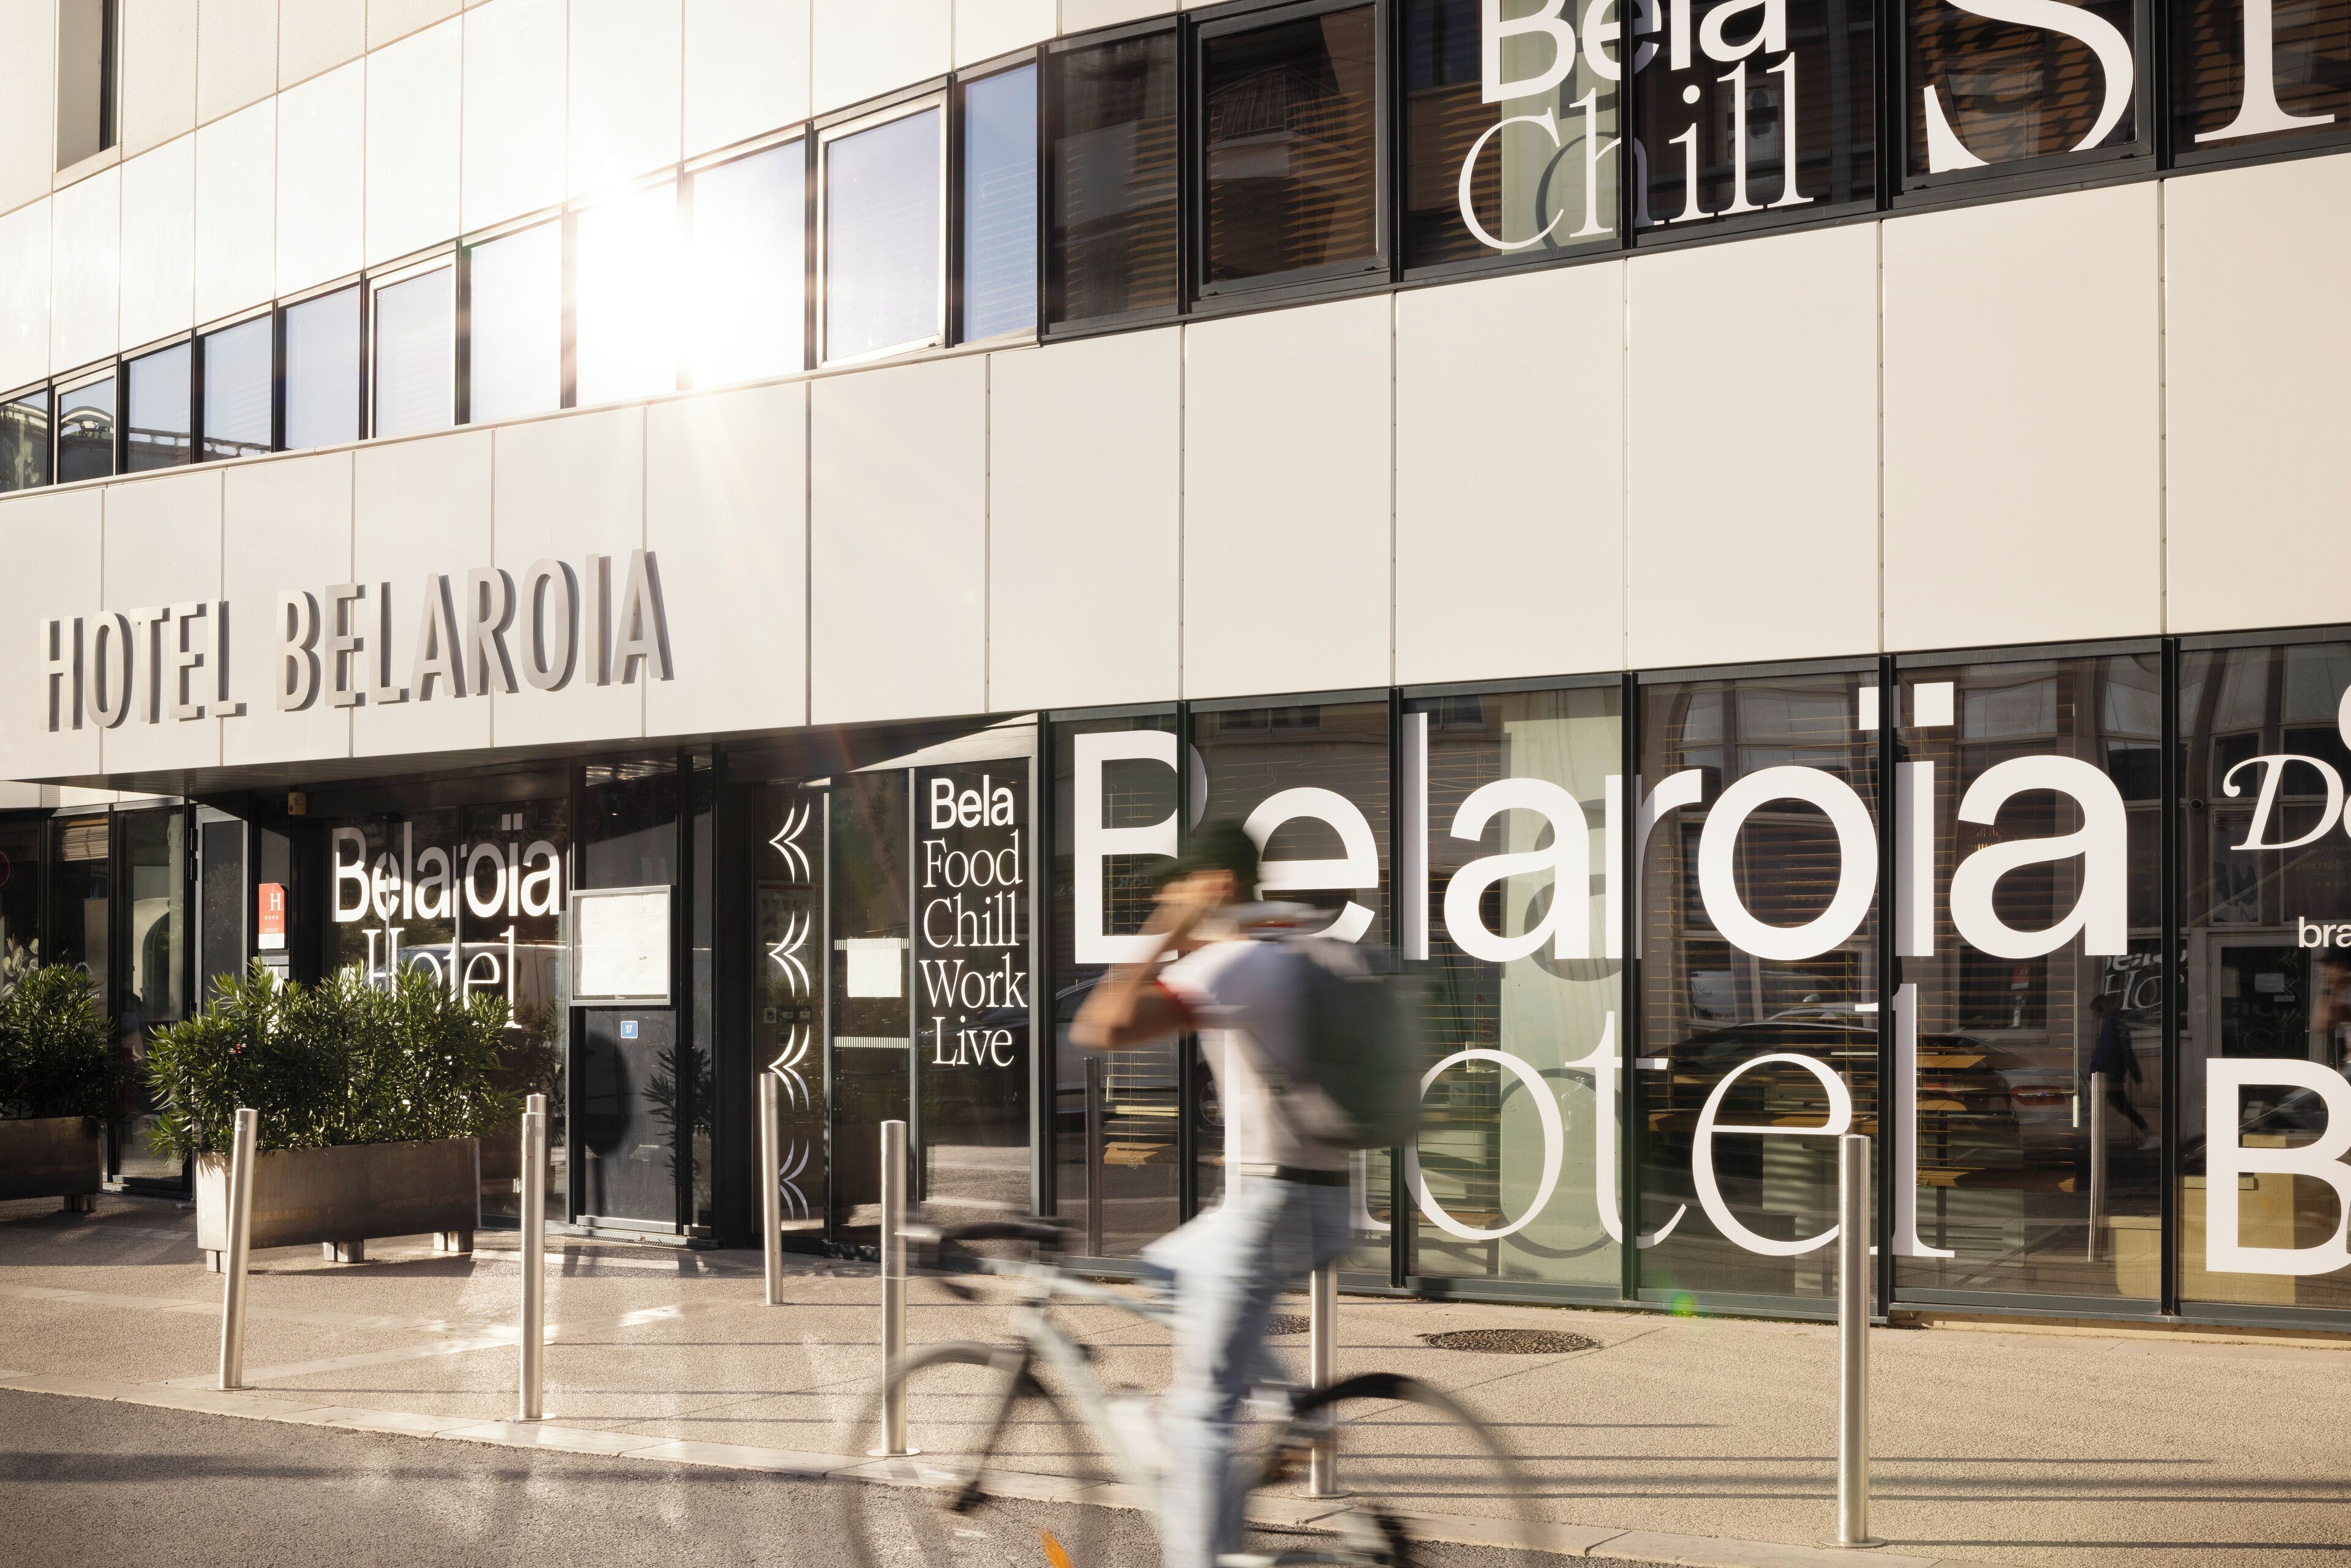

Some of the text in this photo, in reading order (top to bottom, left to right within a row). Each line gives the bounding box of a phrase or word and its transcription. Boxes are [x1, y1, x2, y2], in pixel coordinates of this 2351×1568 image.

[1458, 52, 1813, 250] Chill
[39, 549, 674, 732] HOTEL BELAROIA
[931, 775, 1014, 830] Bela
[1074, 681, 2127, 964] Belaroïa
[2223, 754, 2351, 850] D
[332, 812, 560, 923] Belaroïa
[923, 829, 1023, 888] Food
[270, 893, 282, 911] H
[923, 890, 1019, 948] Chill
[918, 952, 1028, 1008] Work
[626, 1025, 632, 1033] 27
[932, 1016, 1014, 1067] Live
[1198, 983, 1955, 1258] otel
